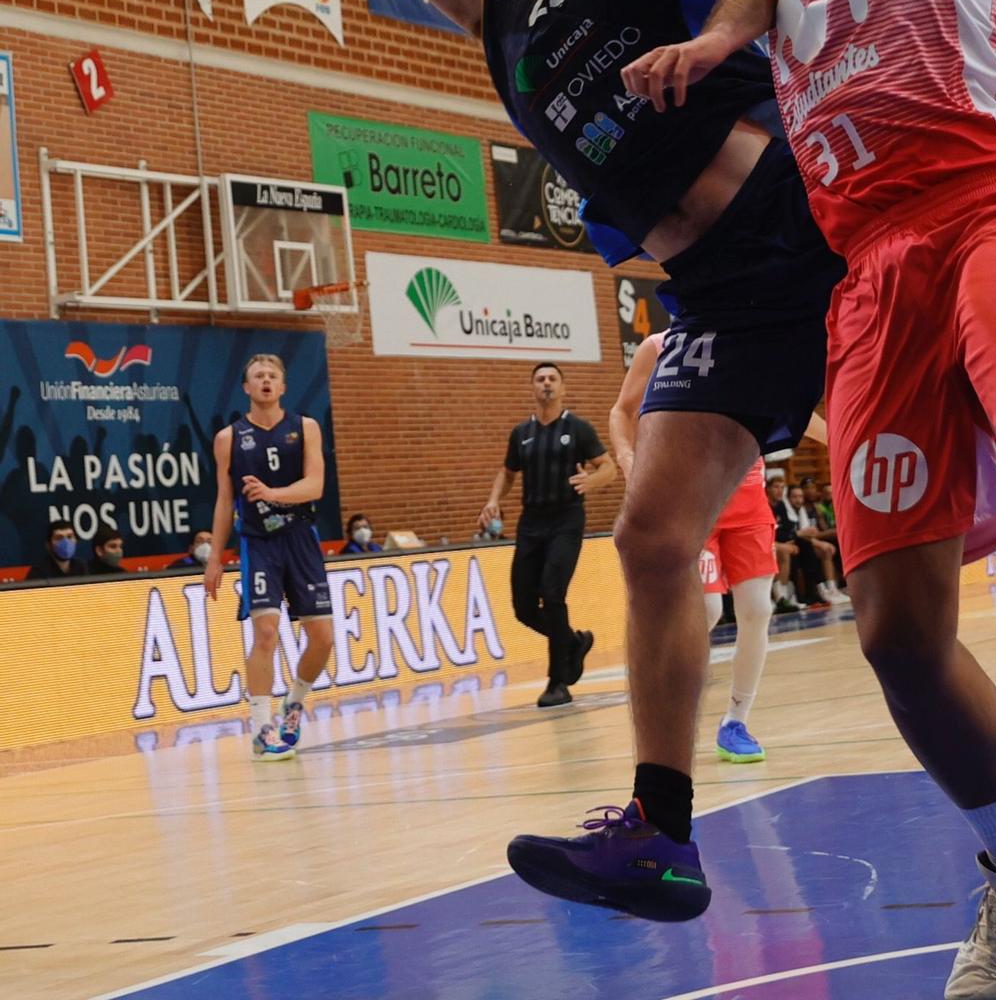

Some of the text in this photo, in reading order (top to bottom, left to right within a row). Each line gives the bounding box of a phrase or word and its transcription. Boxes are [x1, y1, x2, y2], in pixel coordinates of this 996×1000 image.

[82, 58, 106, 100] 2
[567, 26, 641, 97] OVIEDO
[805, 113, 877, 187] 31
[368, 153, 462, 202] Barreto
[459, 308, 571, 343] Unicaja Banco
[656, 331, 717, 378] 24
[653, 379, 691, 391] SPALDING
[87, 405, 115, 421] Desde
[27, 442, 201, 493] LA PASIÓN
[267, 447, 280, 471] 5
[861, 433, 920, 513] hp
[128, 499, 190, 536] UNE
[254, 571, 267, 595] 5
